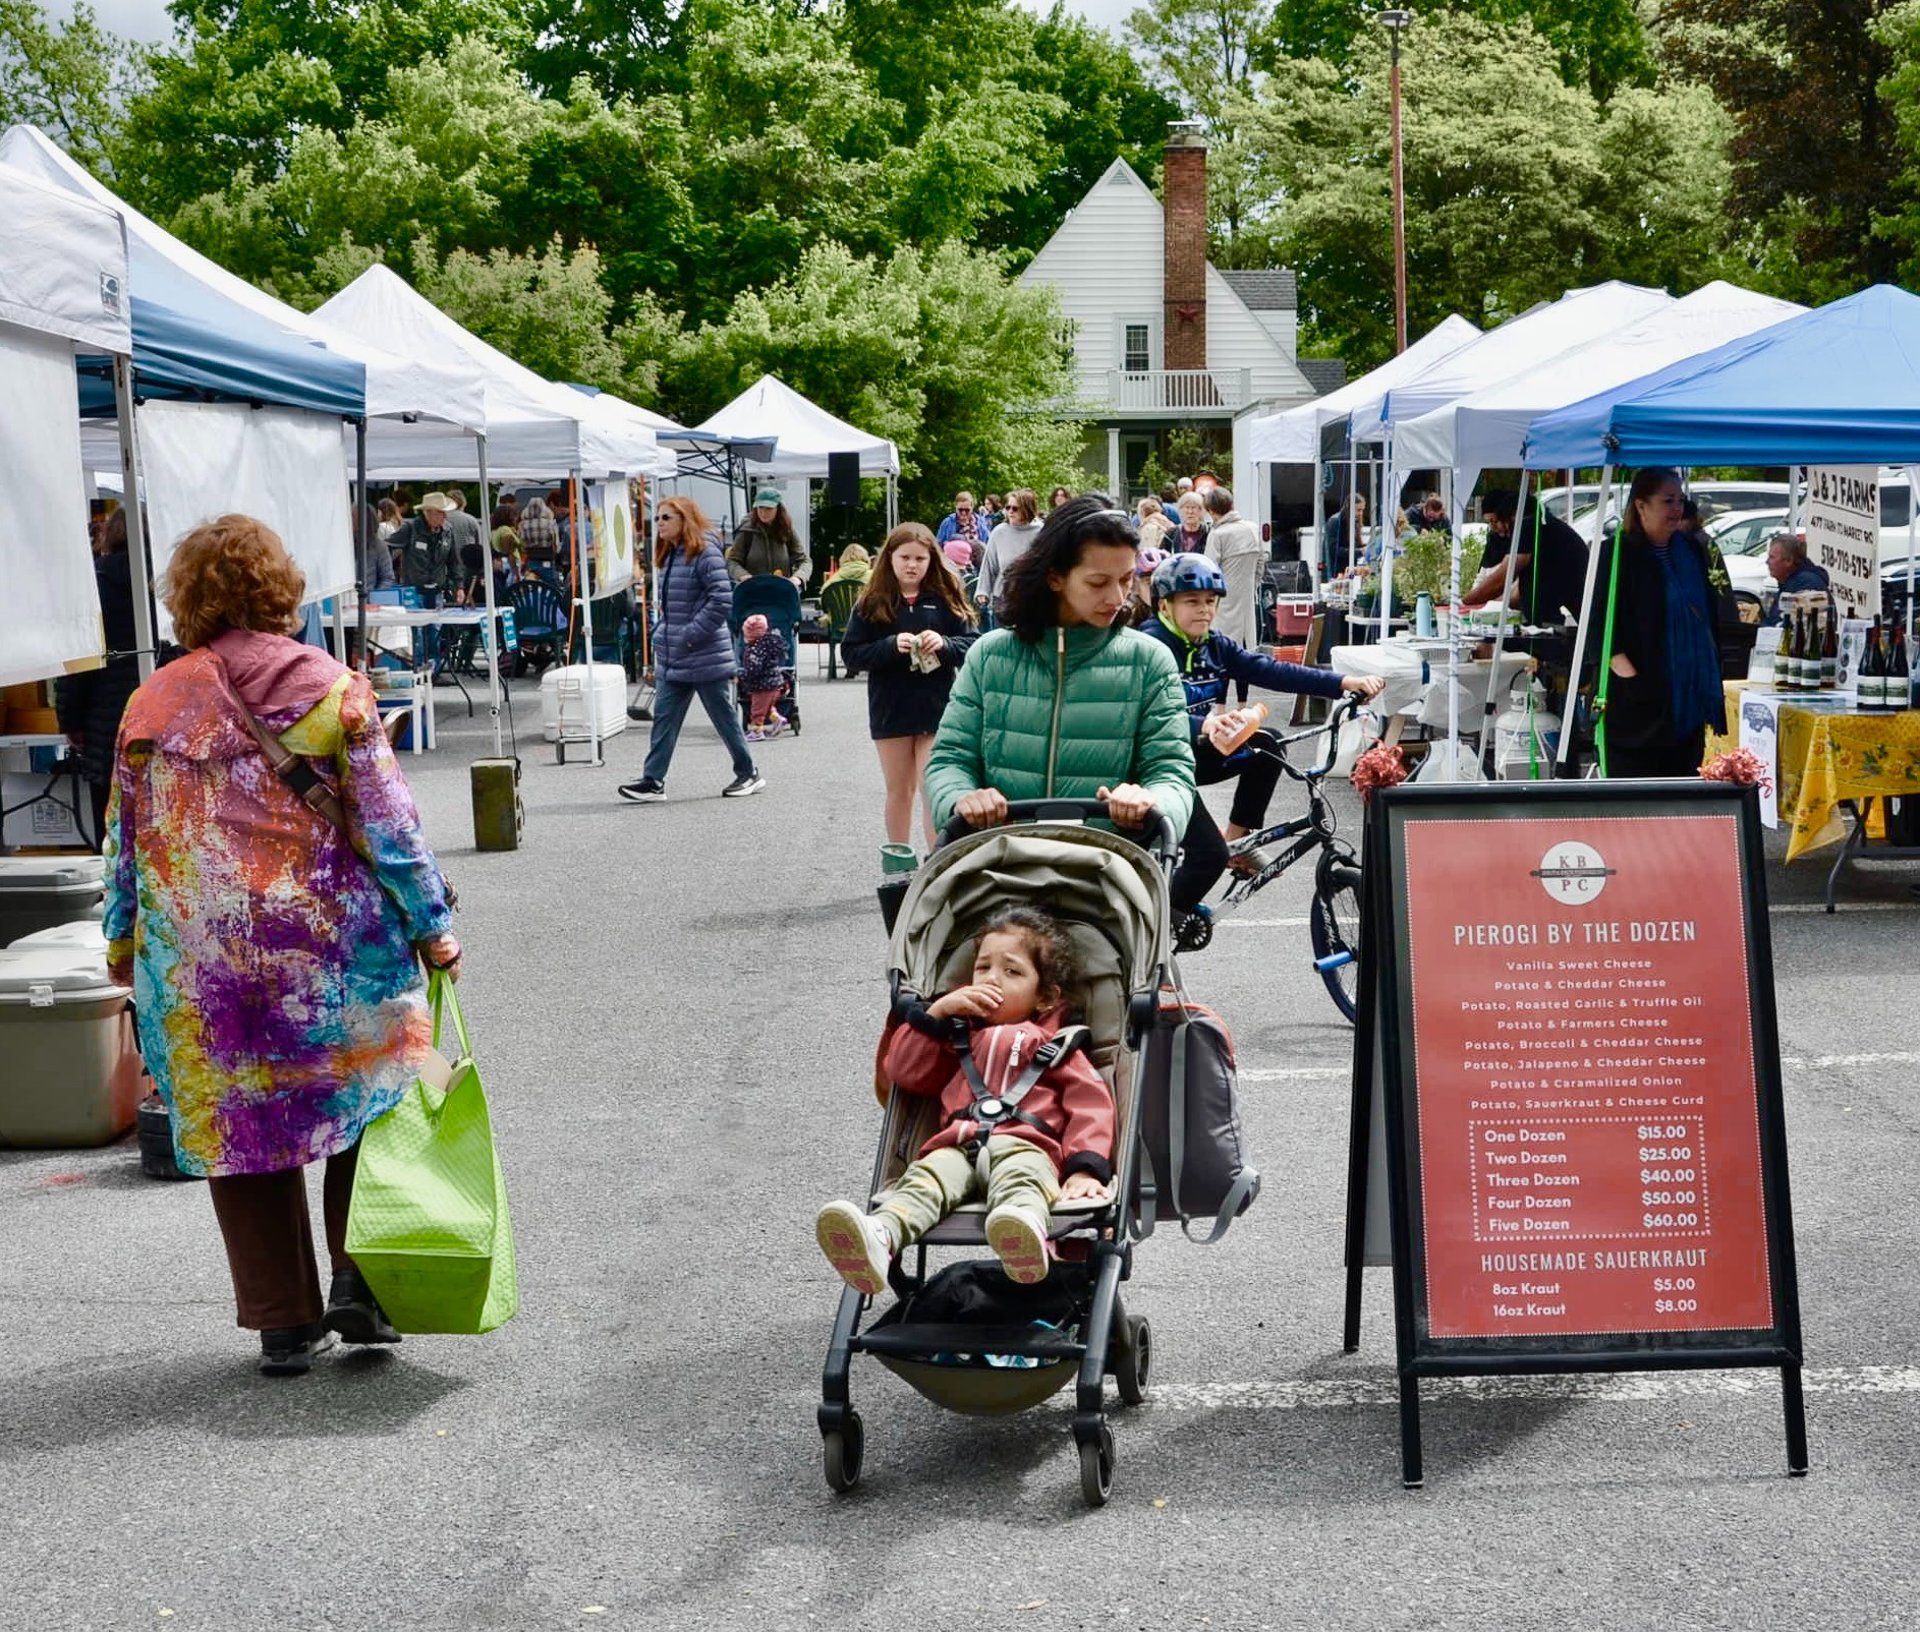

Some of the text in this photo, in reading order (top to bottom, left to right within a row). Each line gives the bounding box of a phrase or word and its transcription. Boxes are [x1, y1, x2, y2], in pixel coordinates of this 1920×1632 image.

[1821, 472, 1829, 500] &
[1831, 474, 1838, 503] J
[1840, 476, 1876, 513] FARMS
[1455, 922, 1695, 945] PIEROGI BY THE DOZEN
[1507, 959, 1651, 970] Vanilla Sweet Cheese
[1495, 979, 1666, 990] Potato & Cheddar Cheese
[1462, 997, 1701, 1011] Potato, Roasted Garlic & Truffle Oil
[1498, 1018, 1668, 1029] Potato & Farmers Cheese
[1465, 1037, 1702, 1051] Potato, Broccoli & Cheddar Cheese
[1464, 1056, 1705, 1071] Potato, Jalapeno & Cheddar Cheese
[1491, 1080, 1535, 1089] Potato
[1541, 1080, 1548, 1088] &
[1643, 1076, 1681, 1086] Onion
[1472, 1096, 1703, 1110] Potato, Sauerkraut & Cheese Curd
[1485, 1125, 1686, 1142] One Dozen $15.00
[1485, 1147, 1691, 1164] Two Dozen $25.00
[1486, 1169, 1695, 1186] Three Dozen $40.00
[1488, 1191, 1695, 1209] Four Dozen $50.00
[1489, 1213, 1697, 1231] Five Dozen $60.00
[1482, 1249, 1706, 1272] HOUSEMADE SAUERKRAUT
[1493, 1278, 1695, 1295] 8oz Kraut $5.00
[1493, 1299, 1697, 1316] 16oz Kraut $8.00
